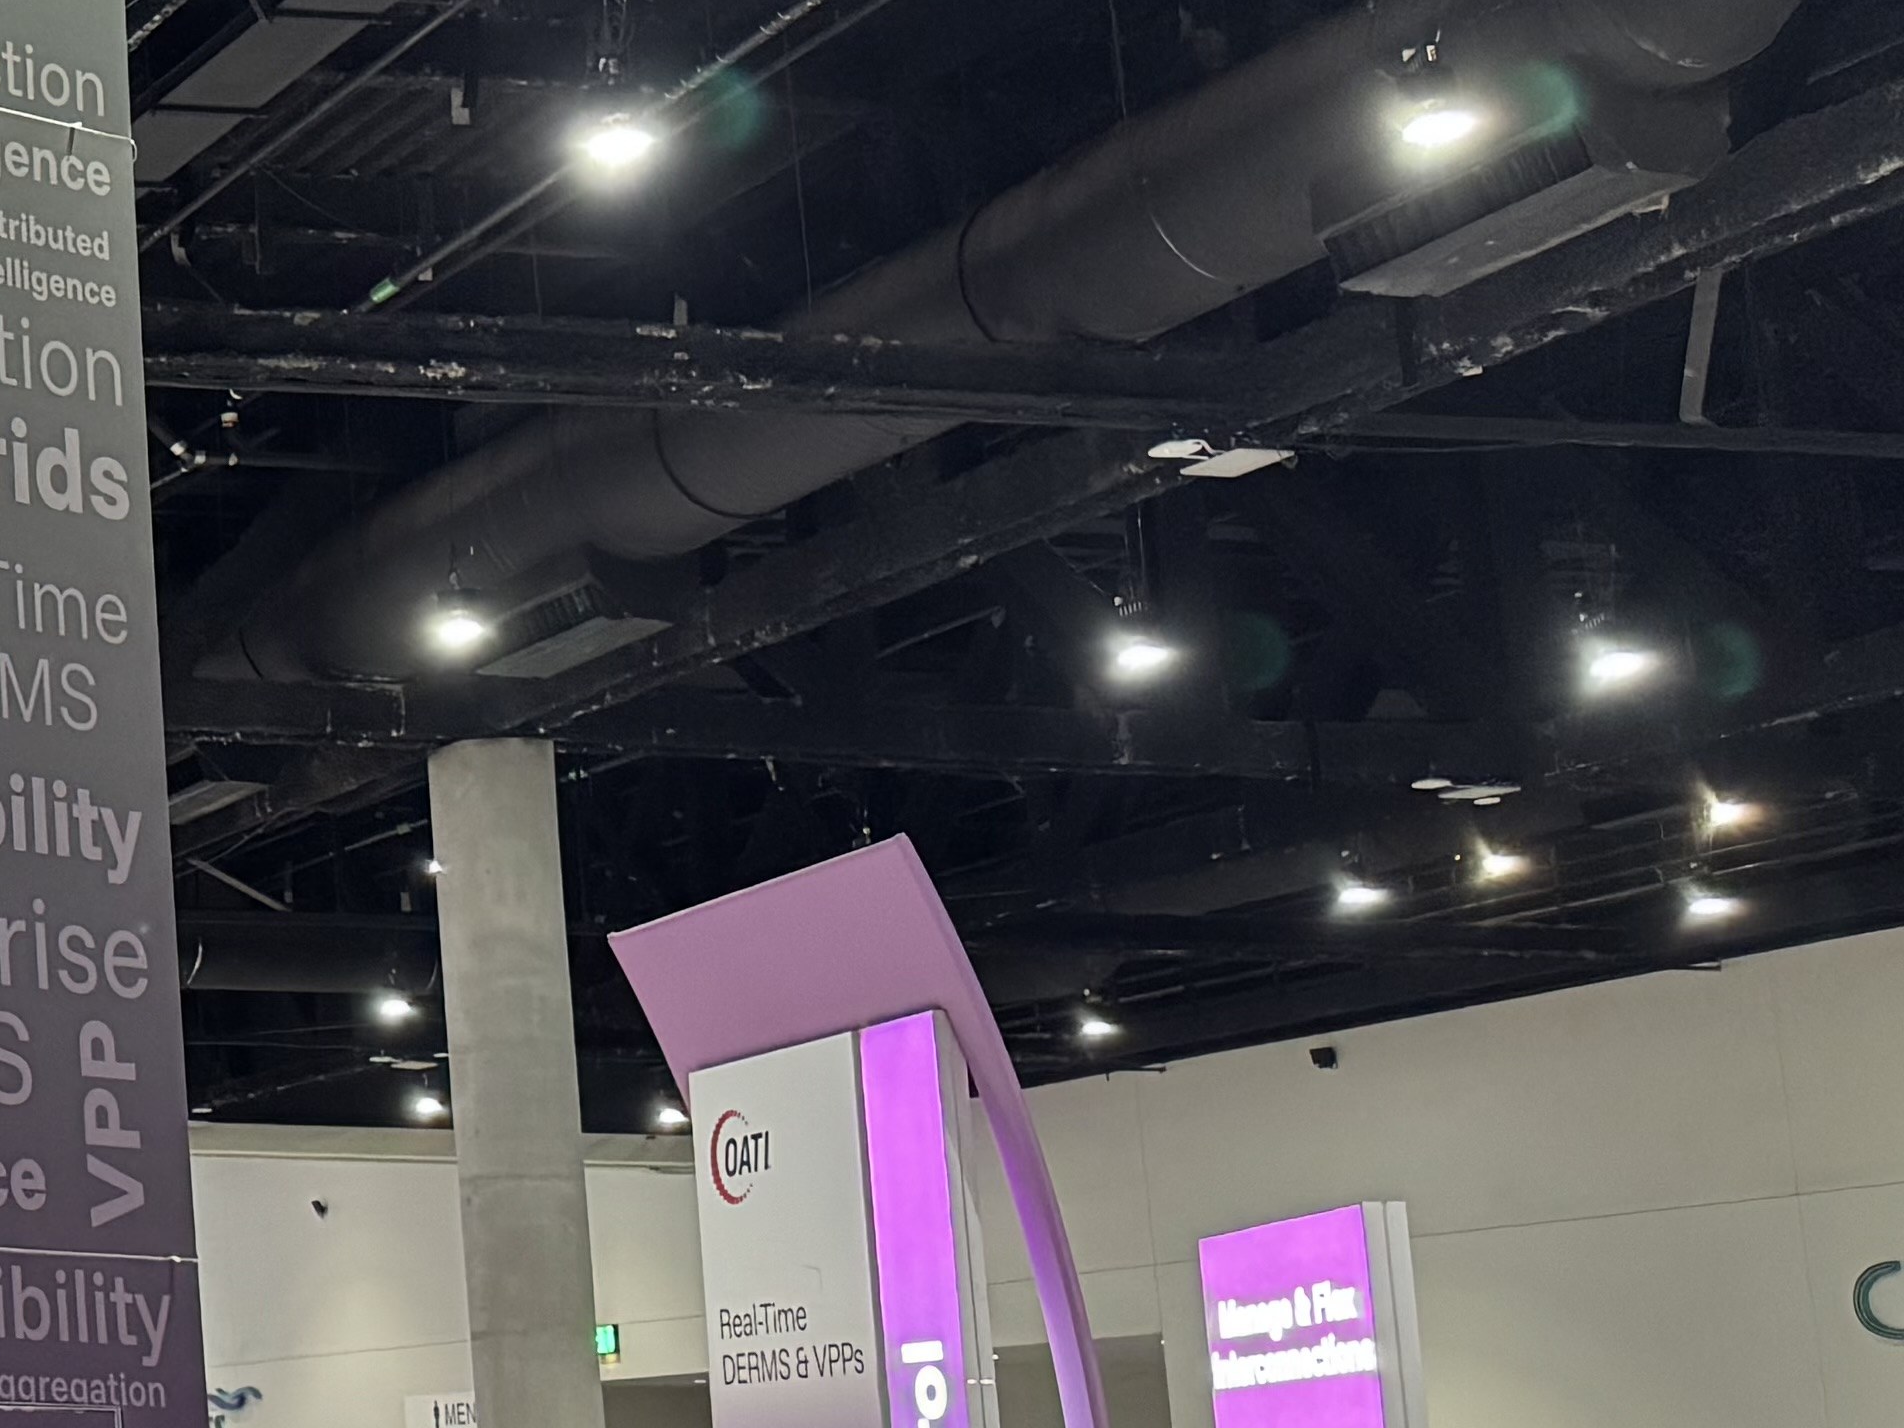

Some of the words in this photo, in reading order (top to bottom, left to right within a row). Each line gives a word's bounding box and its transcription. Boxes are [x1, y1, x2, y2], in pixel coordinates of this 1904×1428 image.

[80, 1019, 146, 1228] VPP
[719, 1303, 808, 1340] Real-Time
[723, 1348, 791, 1385] DERMS
[796, 1346, 809, 1379] &
[812, 1342, 865, 1378] VPPs
[444, 1401, 477, 1428] MEN
